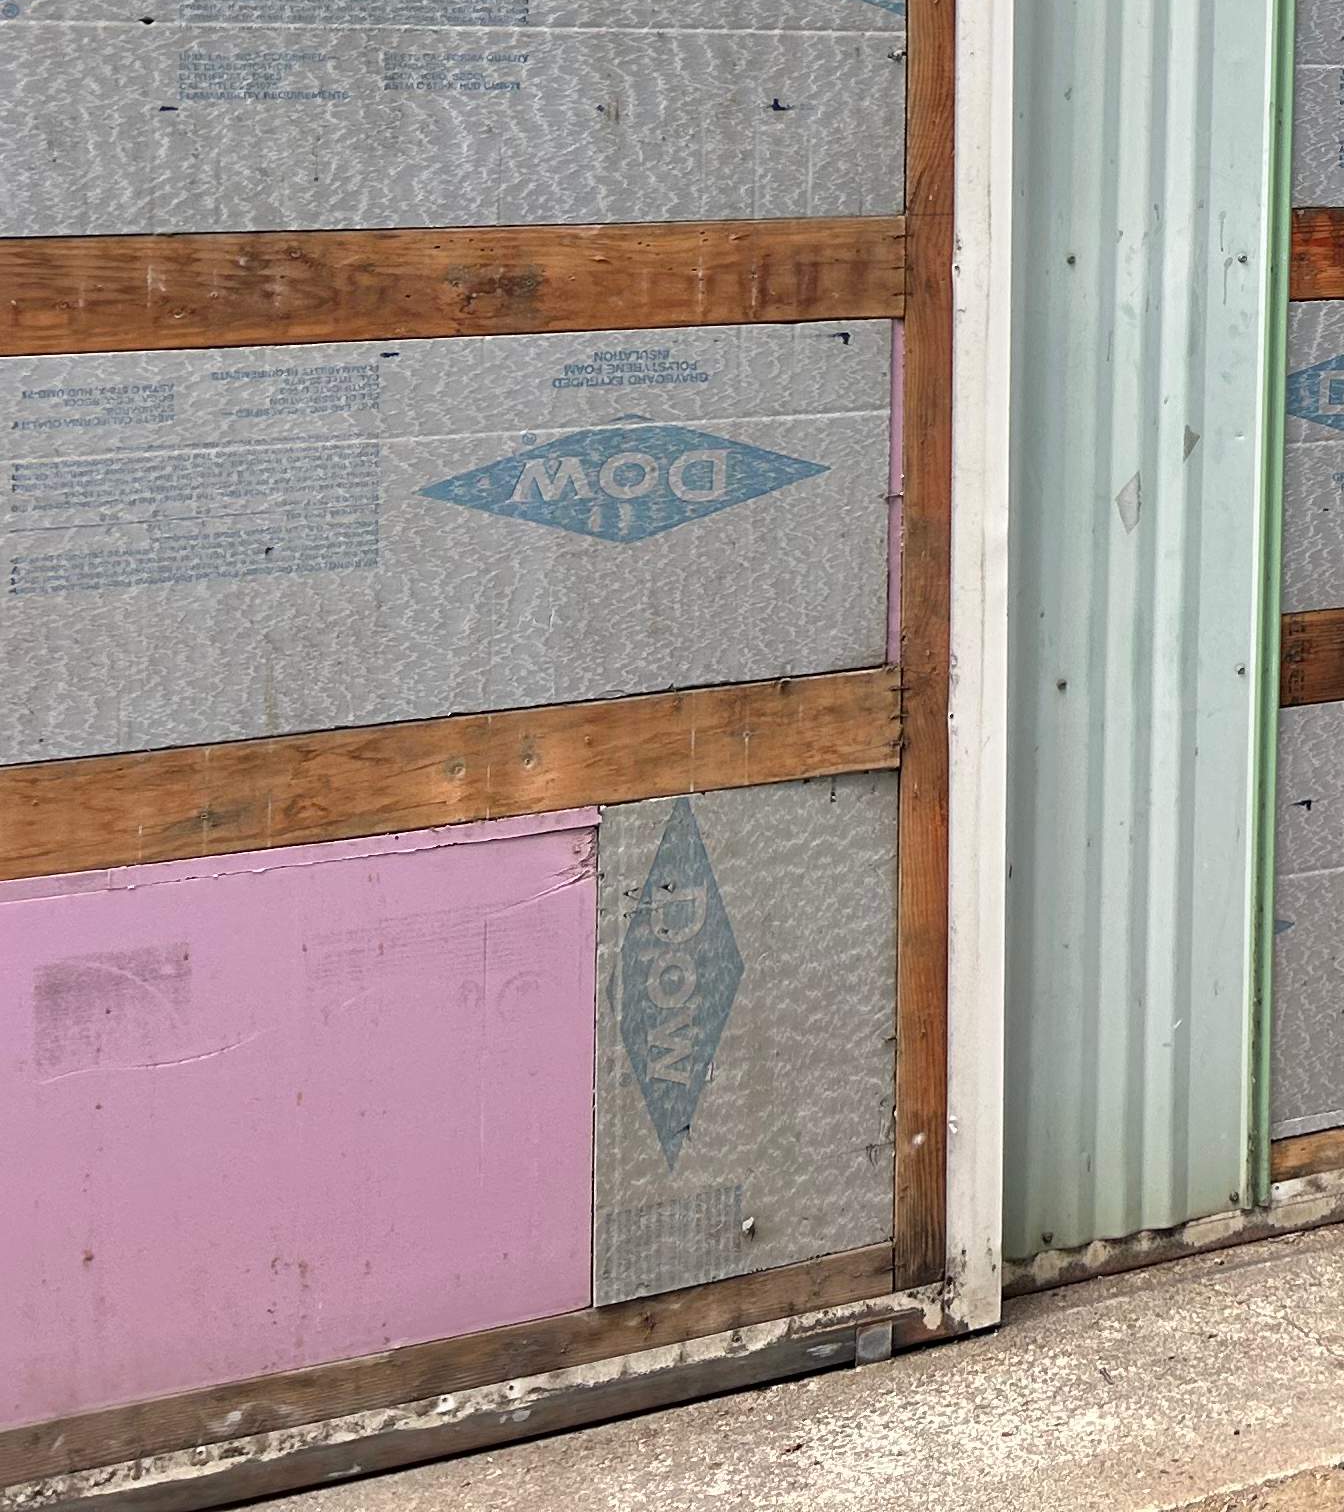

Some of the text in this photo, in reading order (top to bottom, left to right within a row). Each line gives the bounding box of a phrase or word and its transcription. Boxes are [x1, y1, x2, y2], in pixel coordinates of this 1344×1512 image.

[563, 364, 602, 377] FOAM
[592, 349, 671, 363] INSULATION
[507, 448, 728, 504] DOW
[646, 884, 708, 1088] DOW
